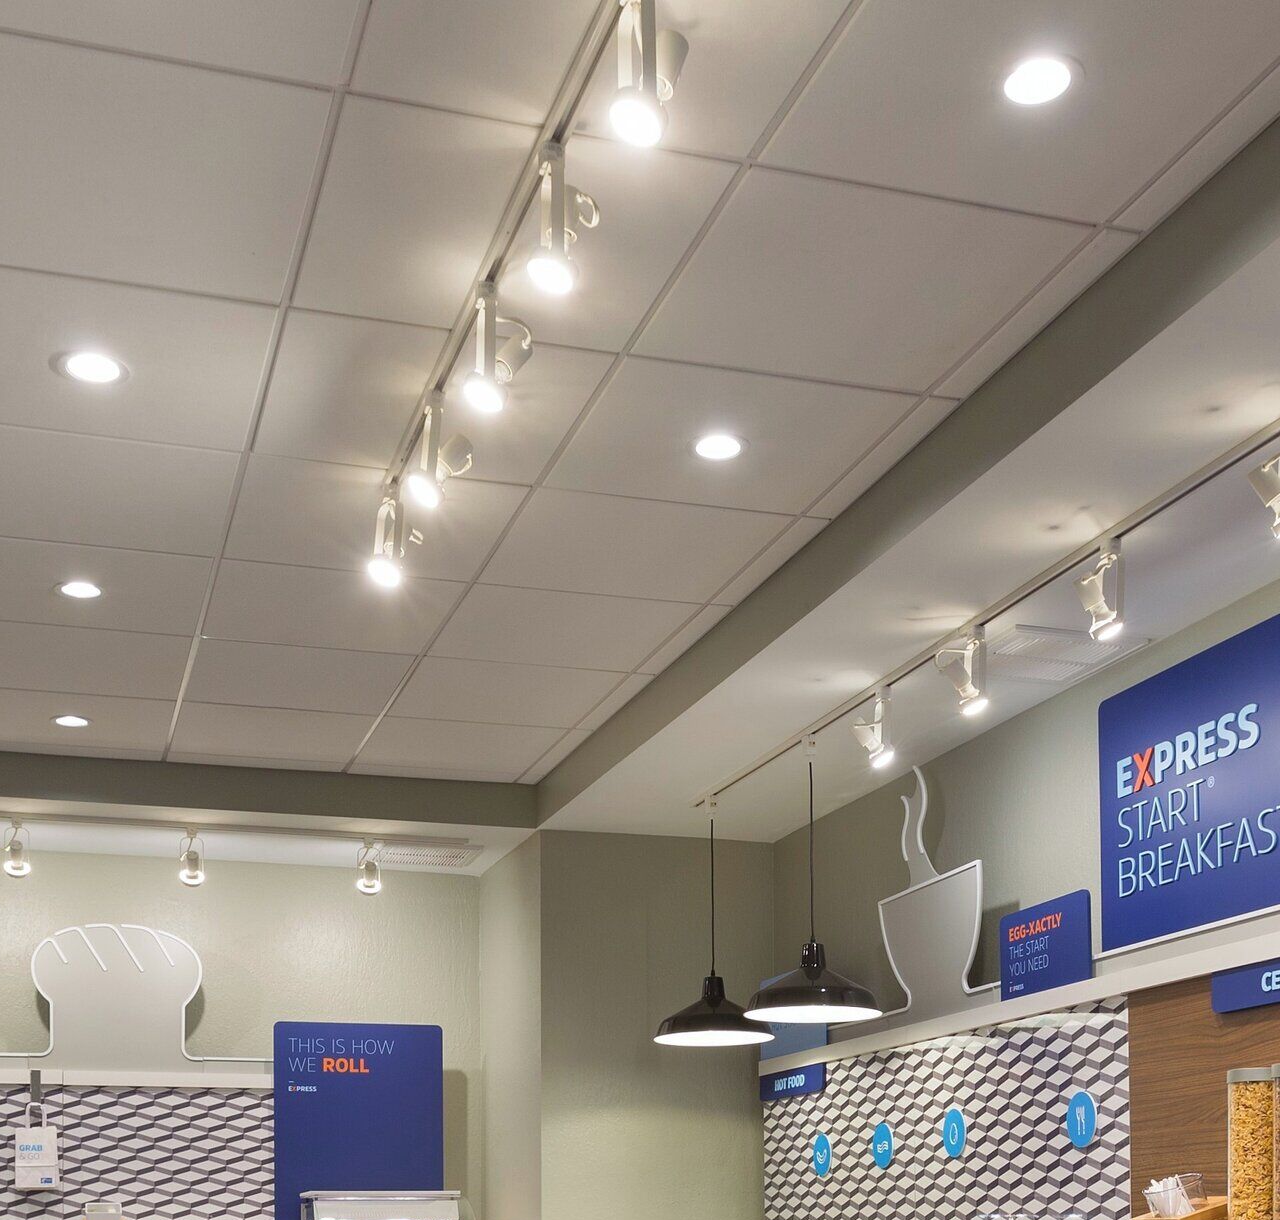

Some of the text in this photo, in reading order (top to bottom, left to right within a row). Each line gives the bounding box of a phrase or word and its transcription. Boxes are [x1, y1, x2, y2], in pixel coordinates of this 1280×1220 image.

[1116, 702, 1261, 799] EXPRESS
[1008, 912, 1063, 943] EGG-XACTLY
[1009, 936, 1049, 960] THE START
[1009, 955, 1049, 977] YOU NEED
[288, 1037, 395, 1055] THIS IS HOW
[288, 1057, 370, 1073] WE ROLL
[774, 1073, 805, 1092] HOT FOOD
[19, 1144, 43, 1152] GRAB
